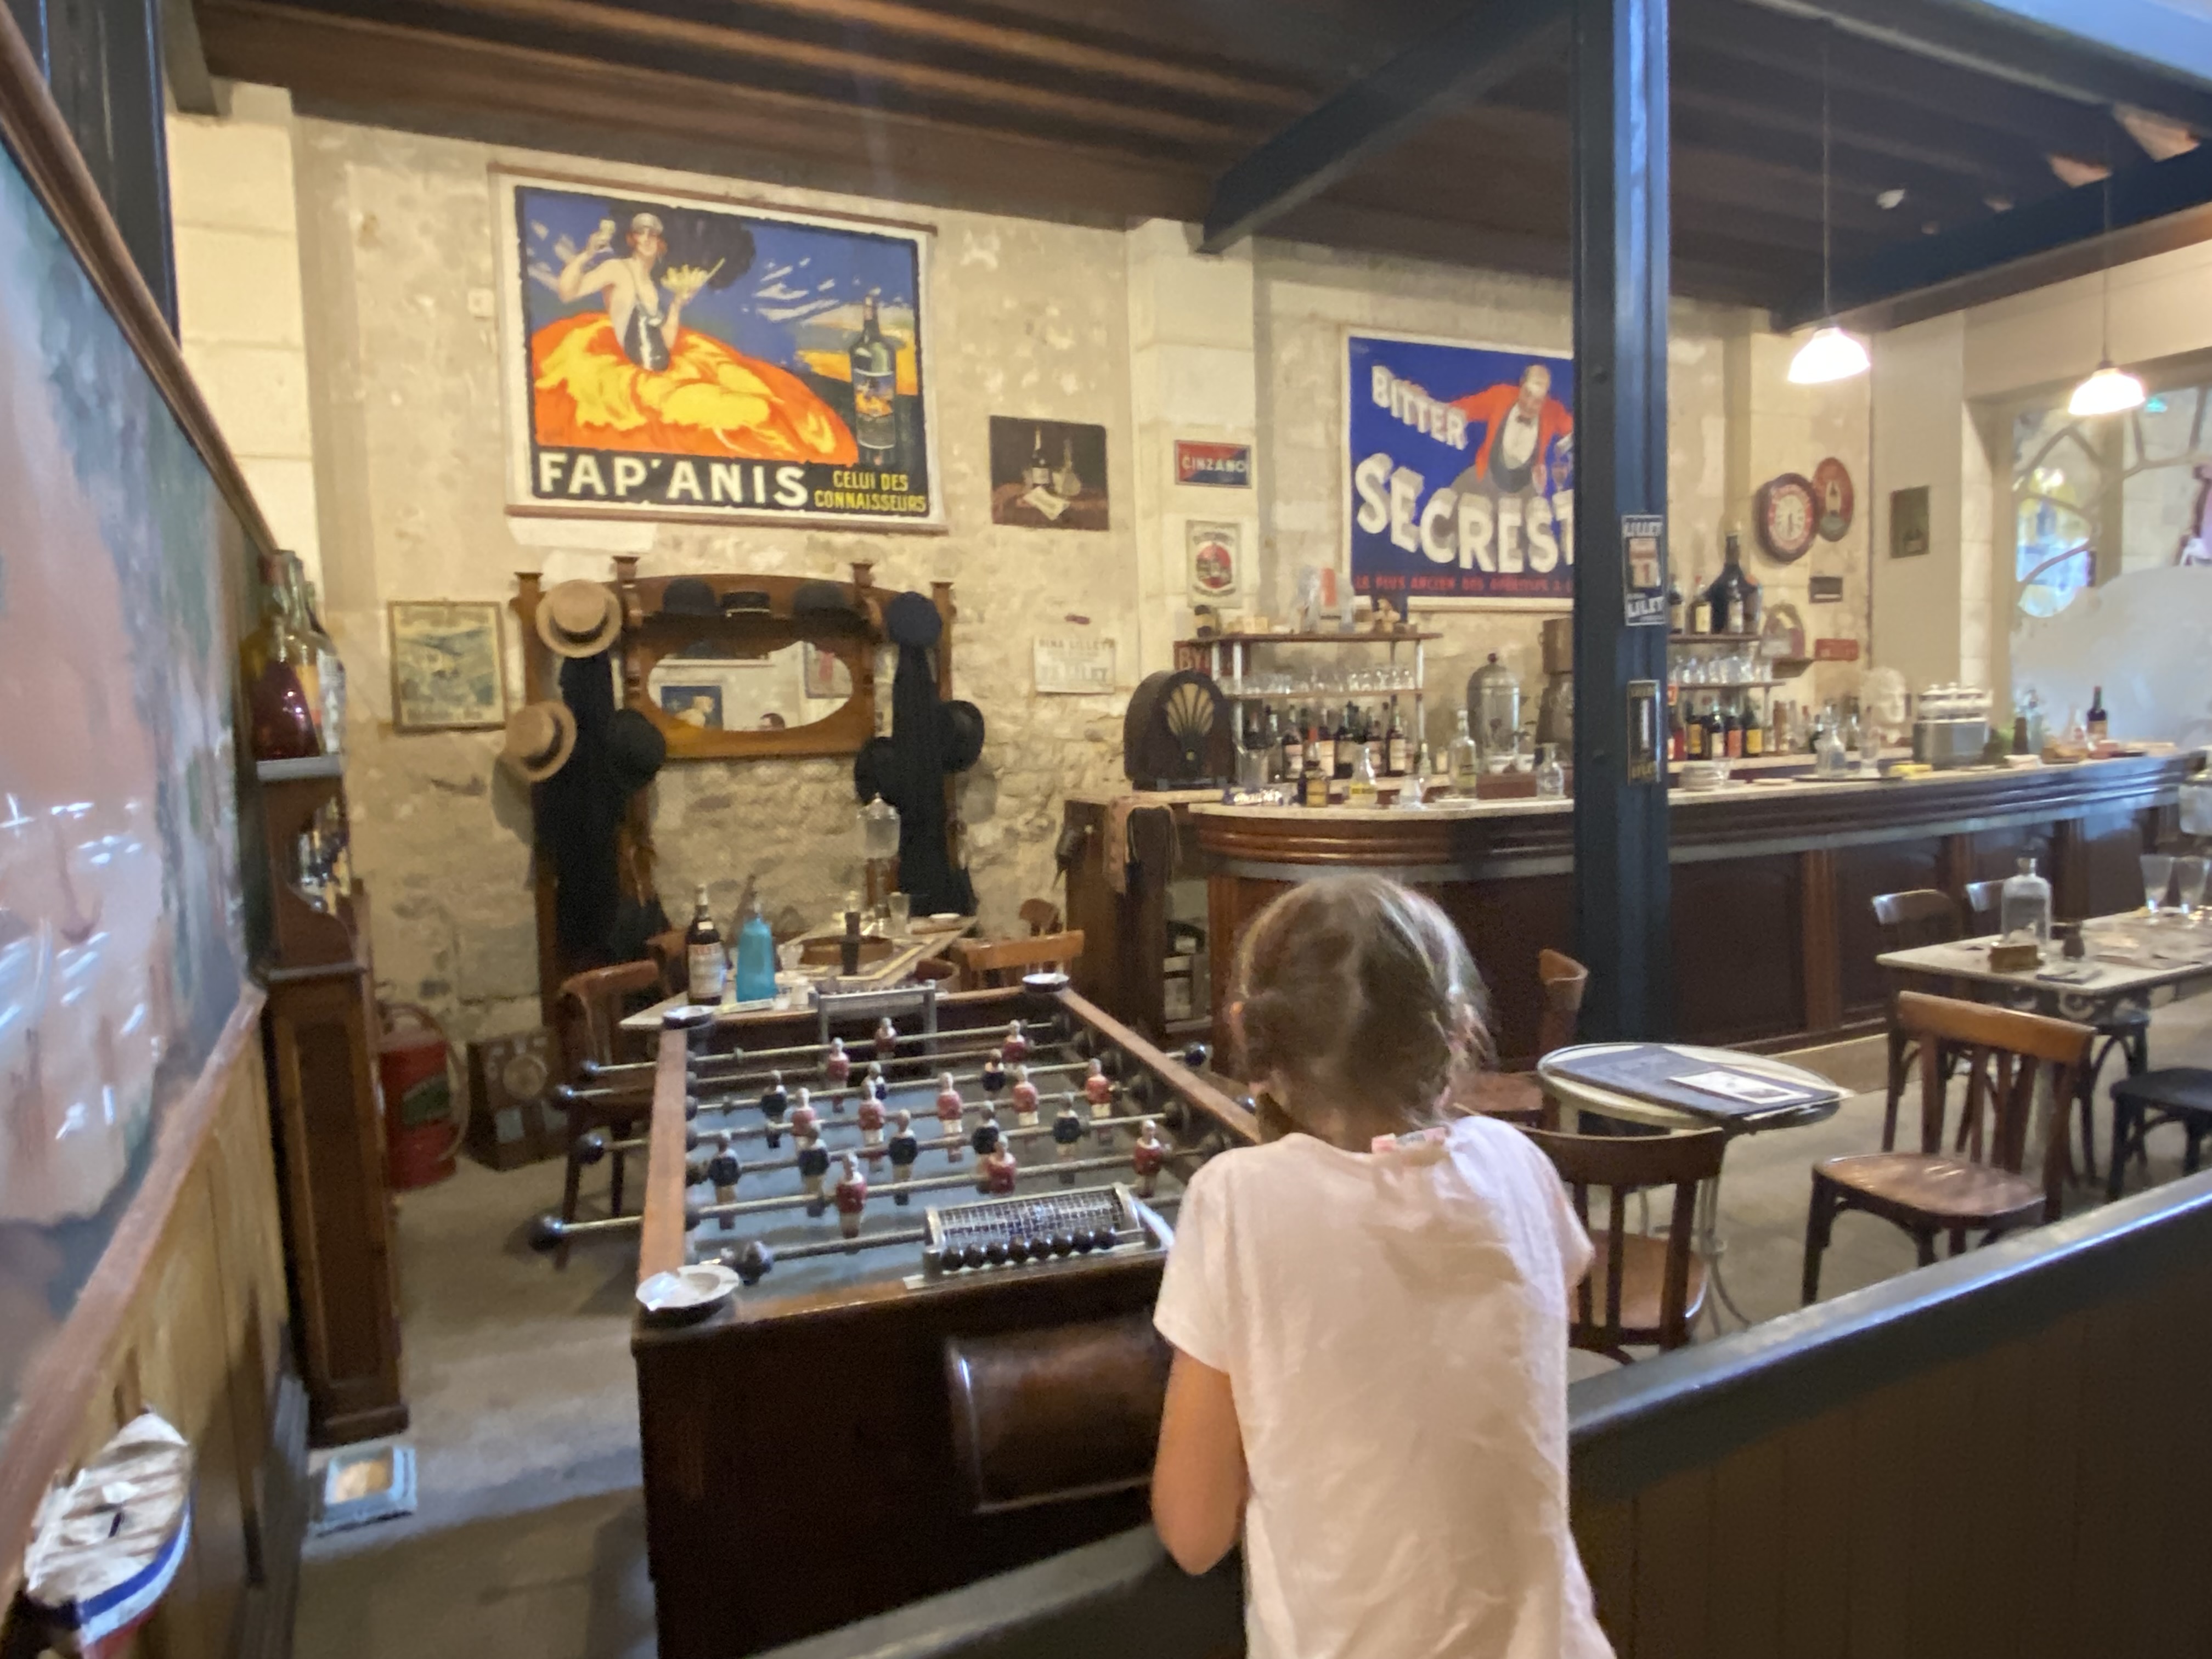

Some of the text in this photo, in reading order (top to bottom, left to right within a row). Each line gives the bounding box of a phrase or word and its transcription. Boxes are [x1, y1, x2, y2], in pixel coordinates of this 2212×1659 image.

[1372, 365, 1469, 450] BITTER
[1182, 455, 1246, 473] CINZANO
[539, 452, 809, 507] FAP'ANIS
[833, 470, 909, 492] CELUI DES
[814, 490, 927, 512] CONNAISSEURS
